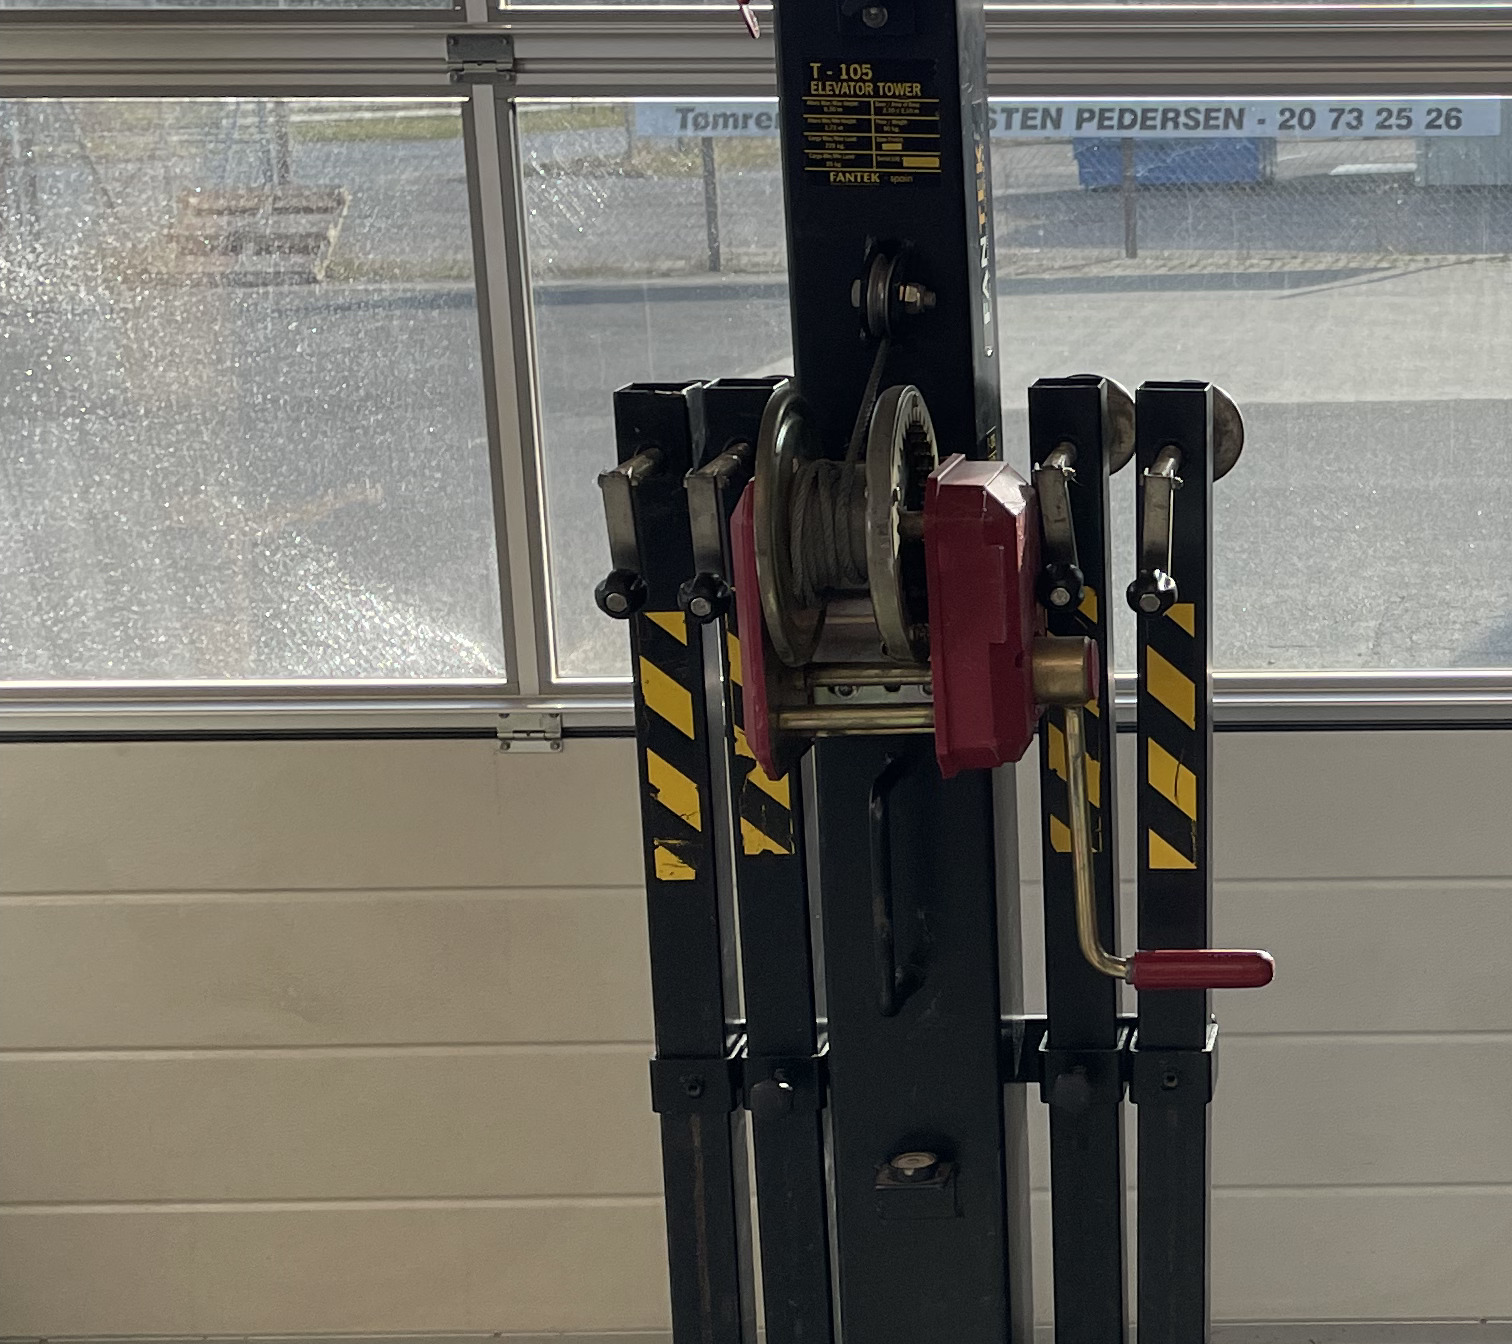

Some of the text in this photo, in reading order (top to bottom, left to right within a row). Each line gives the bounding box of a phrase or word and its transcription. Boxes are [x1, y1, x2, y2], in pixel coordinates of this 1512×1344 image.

[810, 63, 821, 79] T
[840, 63, 873, 80] 105
[810, 81, 922, 96] ELEVATOR TOWER
[1075, 107, 1245, 131] PEDERSEN
[1278, 107, 1316, 131] 20
[1328, 107, 1365, 131] 73
[1375, 107, 1413, 131] 25
[1424, 107, 1463, 131] 26
[829, 172, 880, 183] FANTEK
